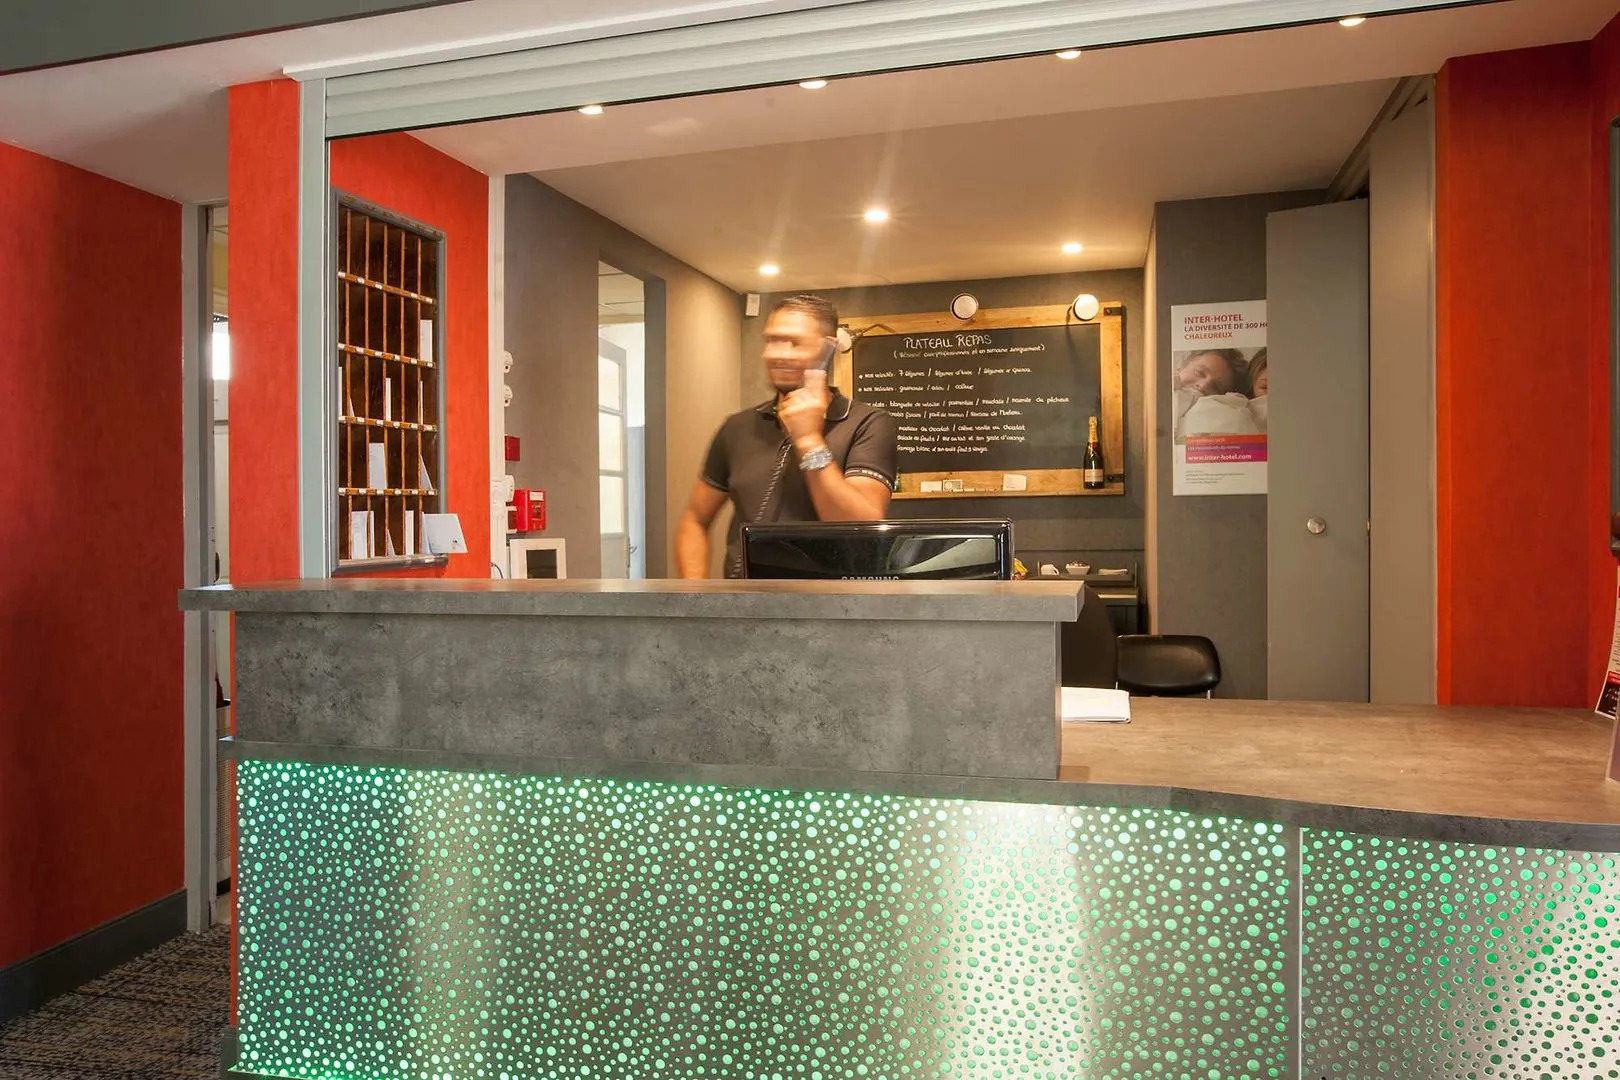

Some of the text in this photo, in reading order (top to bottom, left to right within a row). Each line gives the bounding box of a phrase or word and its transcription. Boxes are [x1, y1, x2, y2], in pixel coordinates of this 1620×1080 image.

[903, 334, 992, 349] PLATEAU REPAS
[1184, 331, 1233, 340] CHALEUREUX
